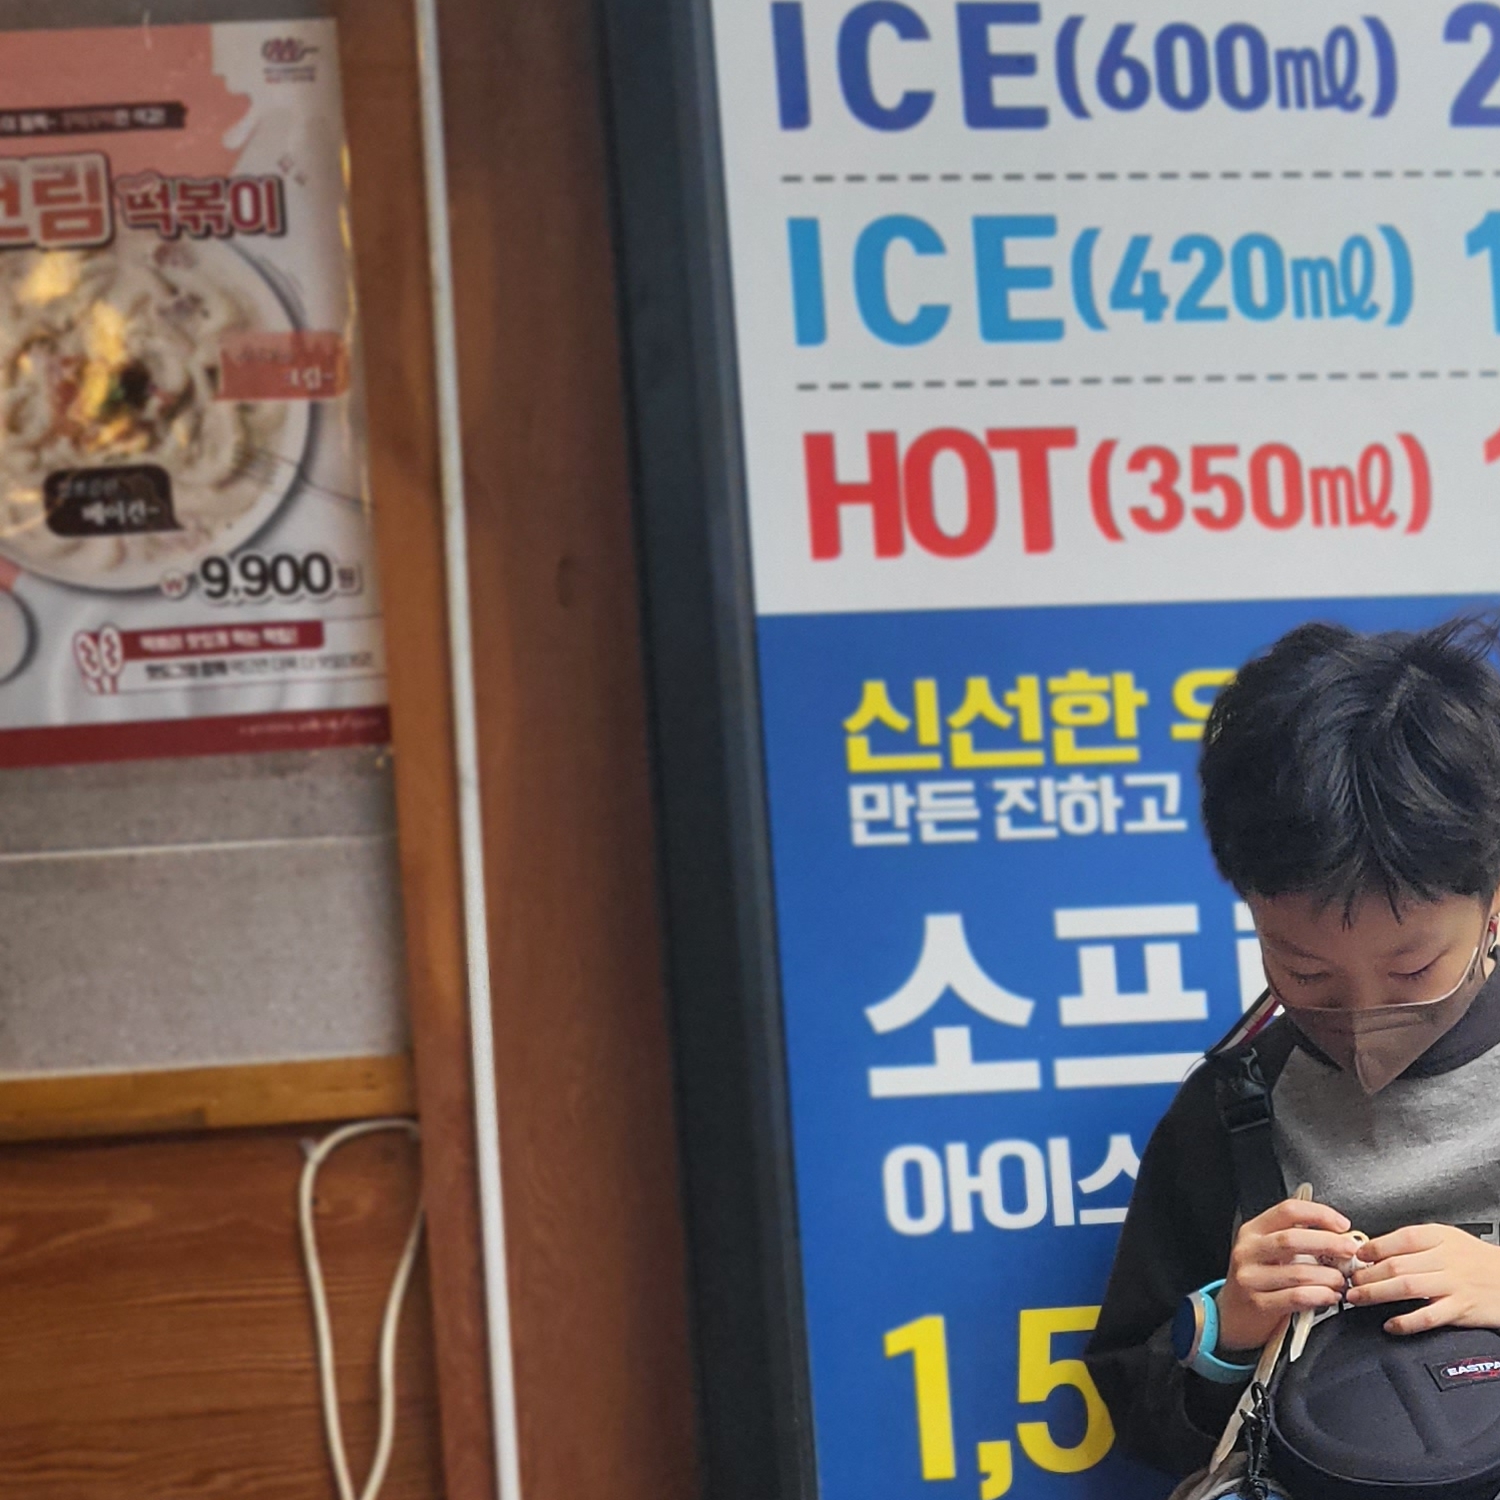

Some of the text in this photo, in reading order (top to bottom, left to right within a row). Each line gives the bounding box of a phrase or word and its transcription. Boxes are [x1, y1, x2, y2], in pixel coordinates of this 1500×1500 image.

[124, 178, 280, 235] 떡볶이
[842, 669, 1149, 773] 신선한
[848, 774, 1188, 846] 만든 진하고
[864, 901, 1272, 1099] 소프
